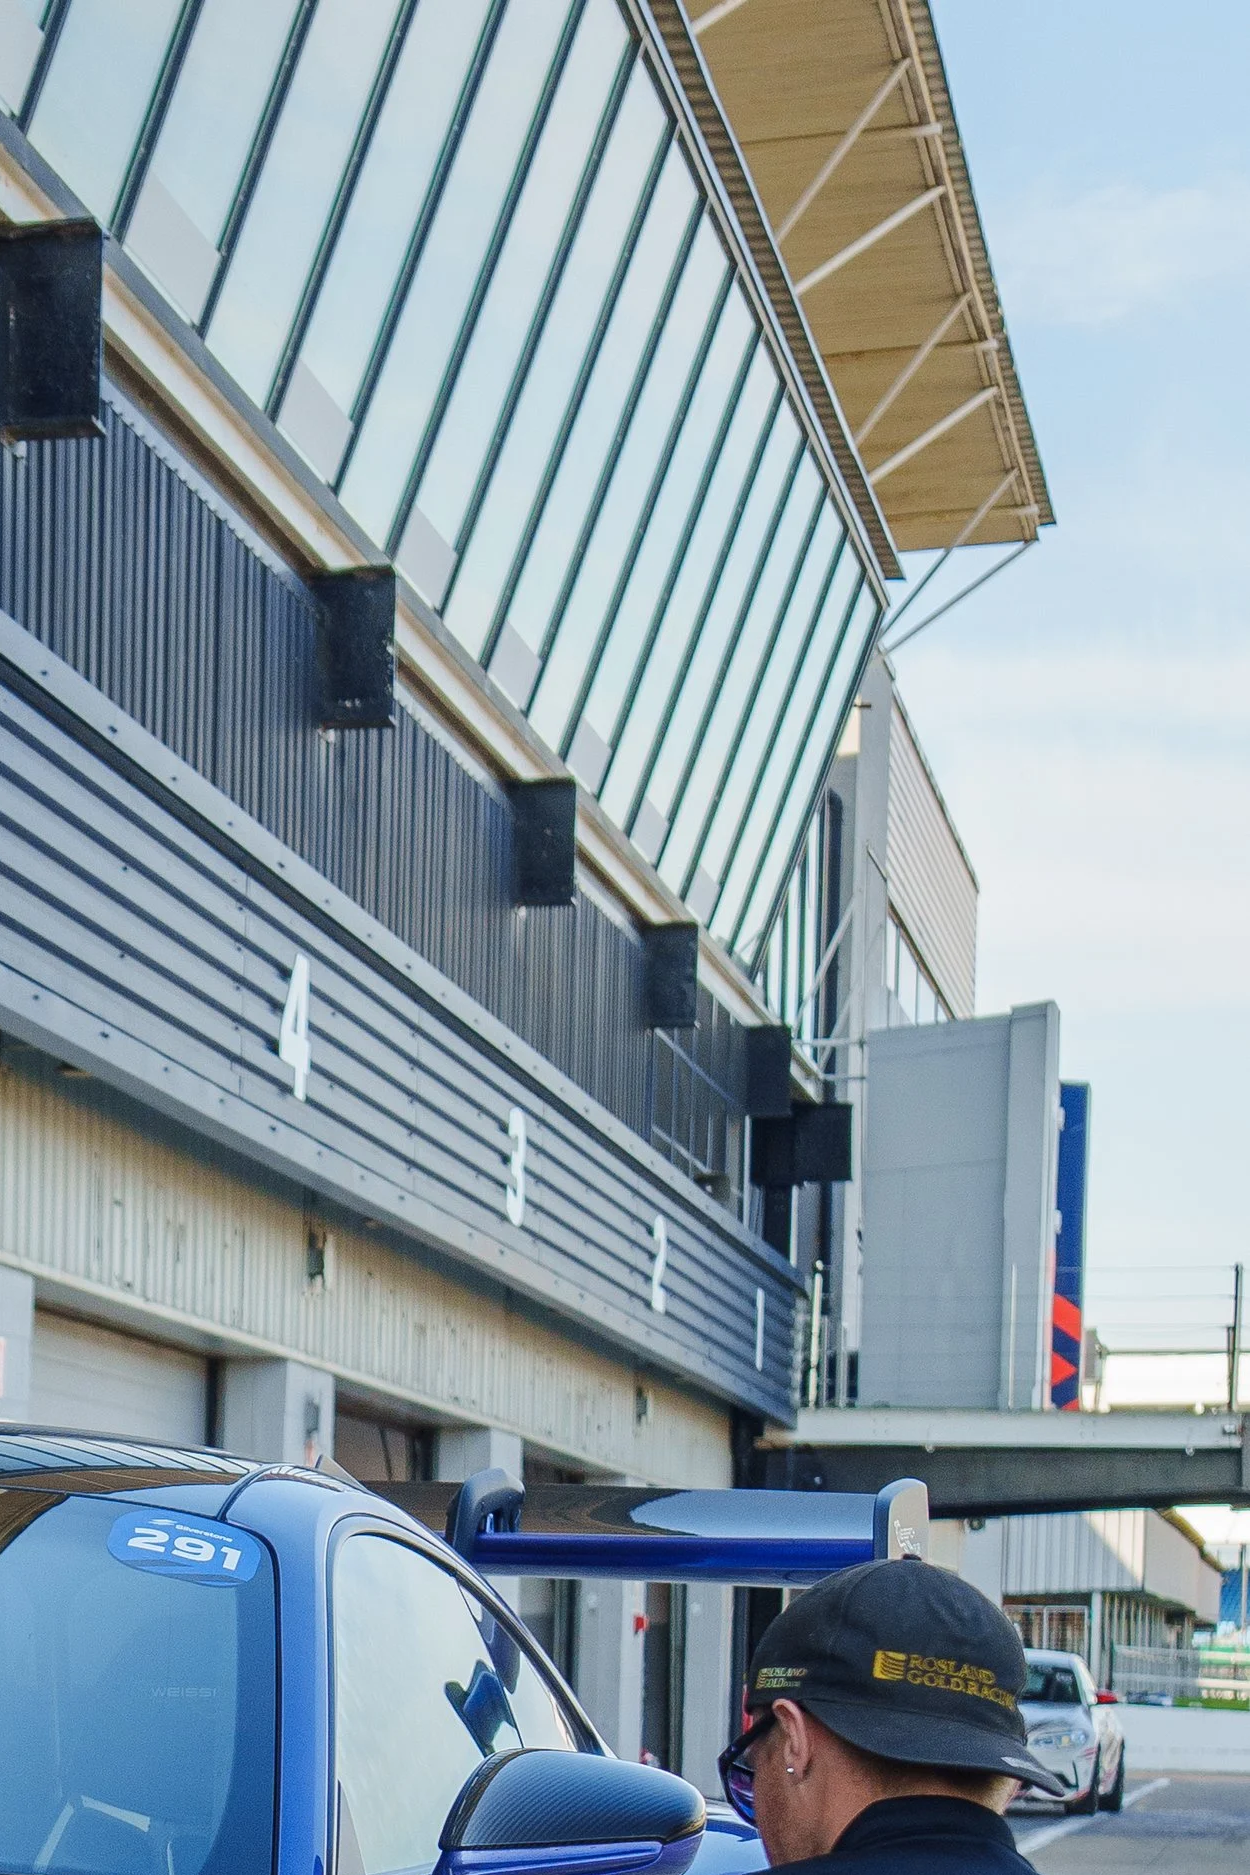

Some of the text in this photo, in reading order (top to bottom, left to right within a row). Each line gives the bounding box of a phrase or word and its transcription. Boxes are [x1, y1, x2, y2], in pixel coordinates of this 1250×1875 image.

[278, 952, 312, 1102] 4
[505, 1106, 528, 1227] 3
[650, 1213, 667, 1314] 2
[755, 1287, 765, 1371] 1
[127, 1527, 242, 1571] 291
[174, 1524, 233, 1543] Silverstone
[908, 1654, 997, 1685] ROSLAND
